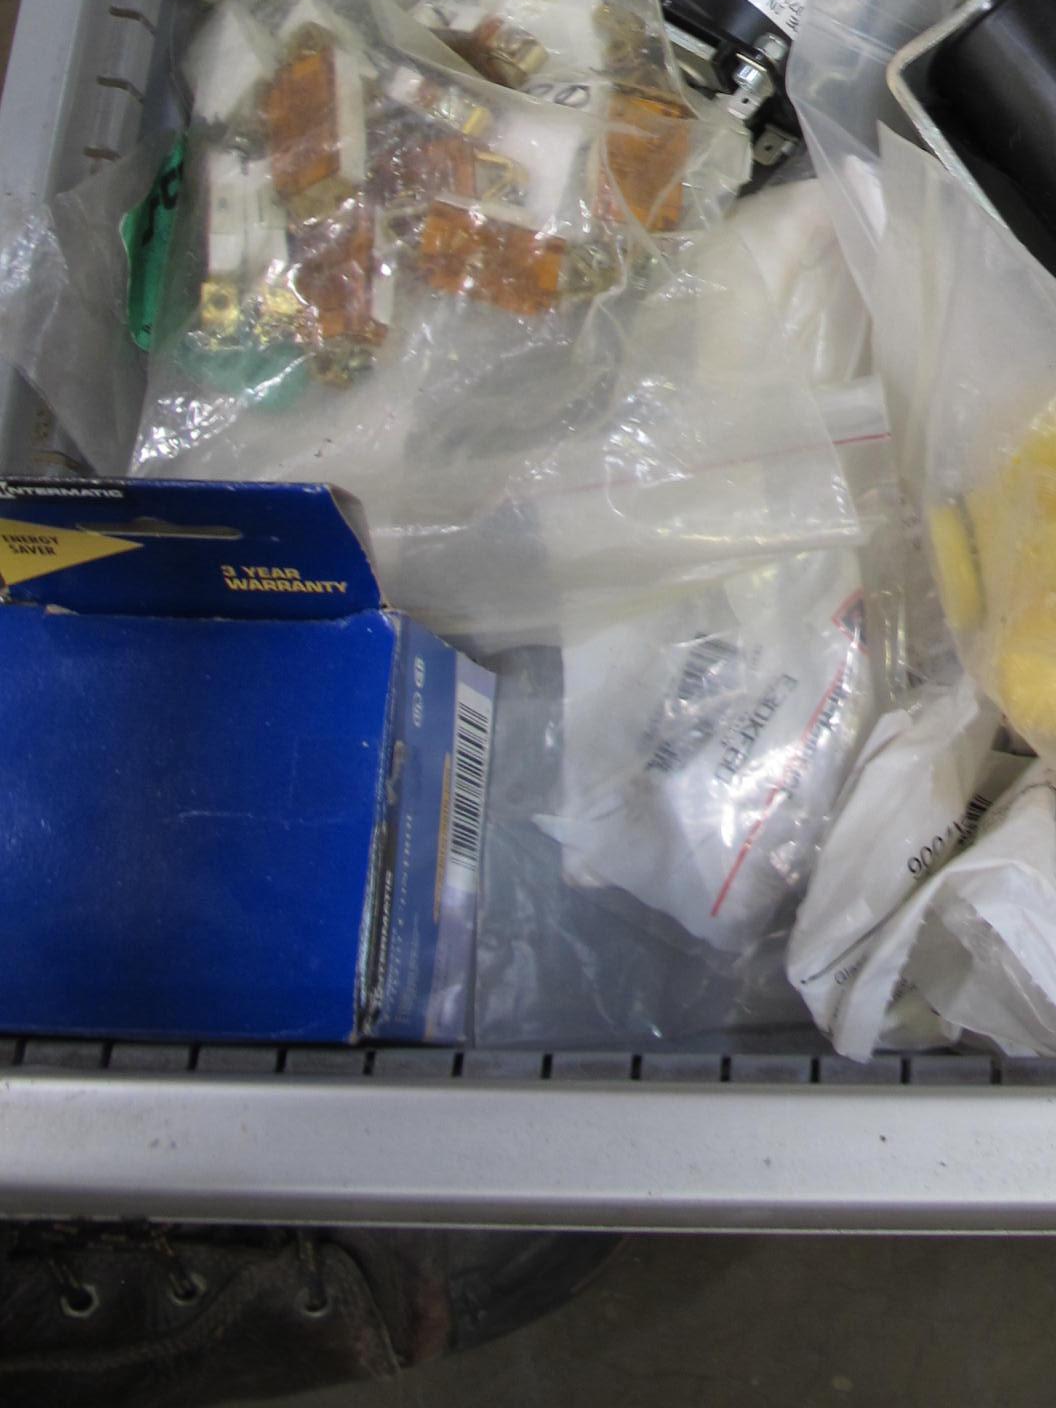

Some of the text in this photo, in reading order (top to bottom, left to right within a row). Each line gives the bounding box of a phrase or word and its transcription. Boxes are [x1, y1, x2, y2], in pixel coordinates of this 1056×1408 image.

[2, 533, 60, 546] ENERGY
[9, 543, 57, 556] SAVER
[222, 566, 300, 580] 3 YEAR
[225, 578, 348, 594] WARRANTY
